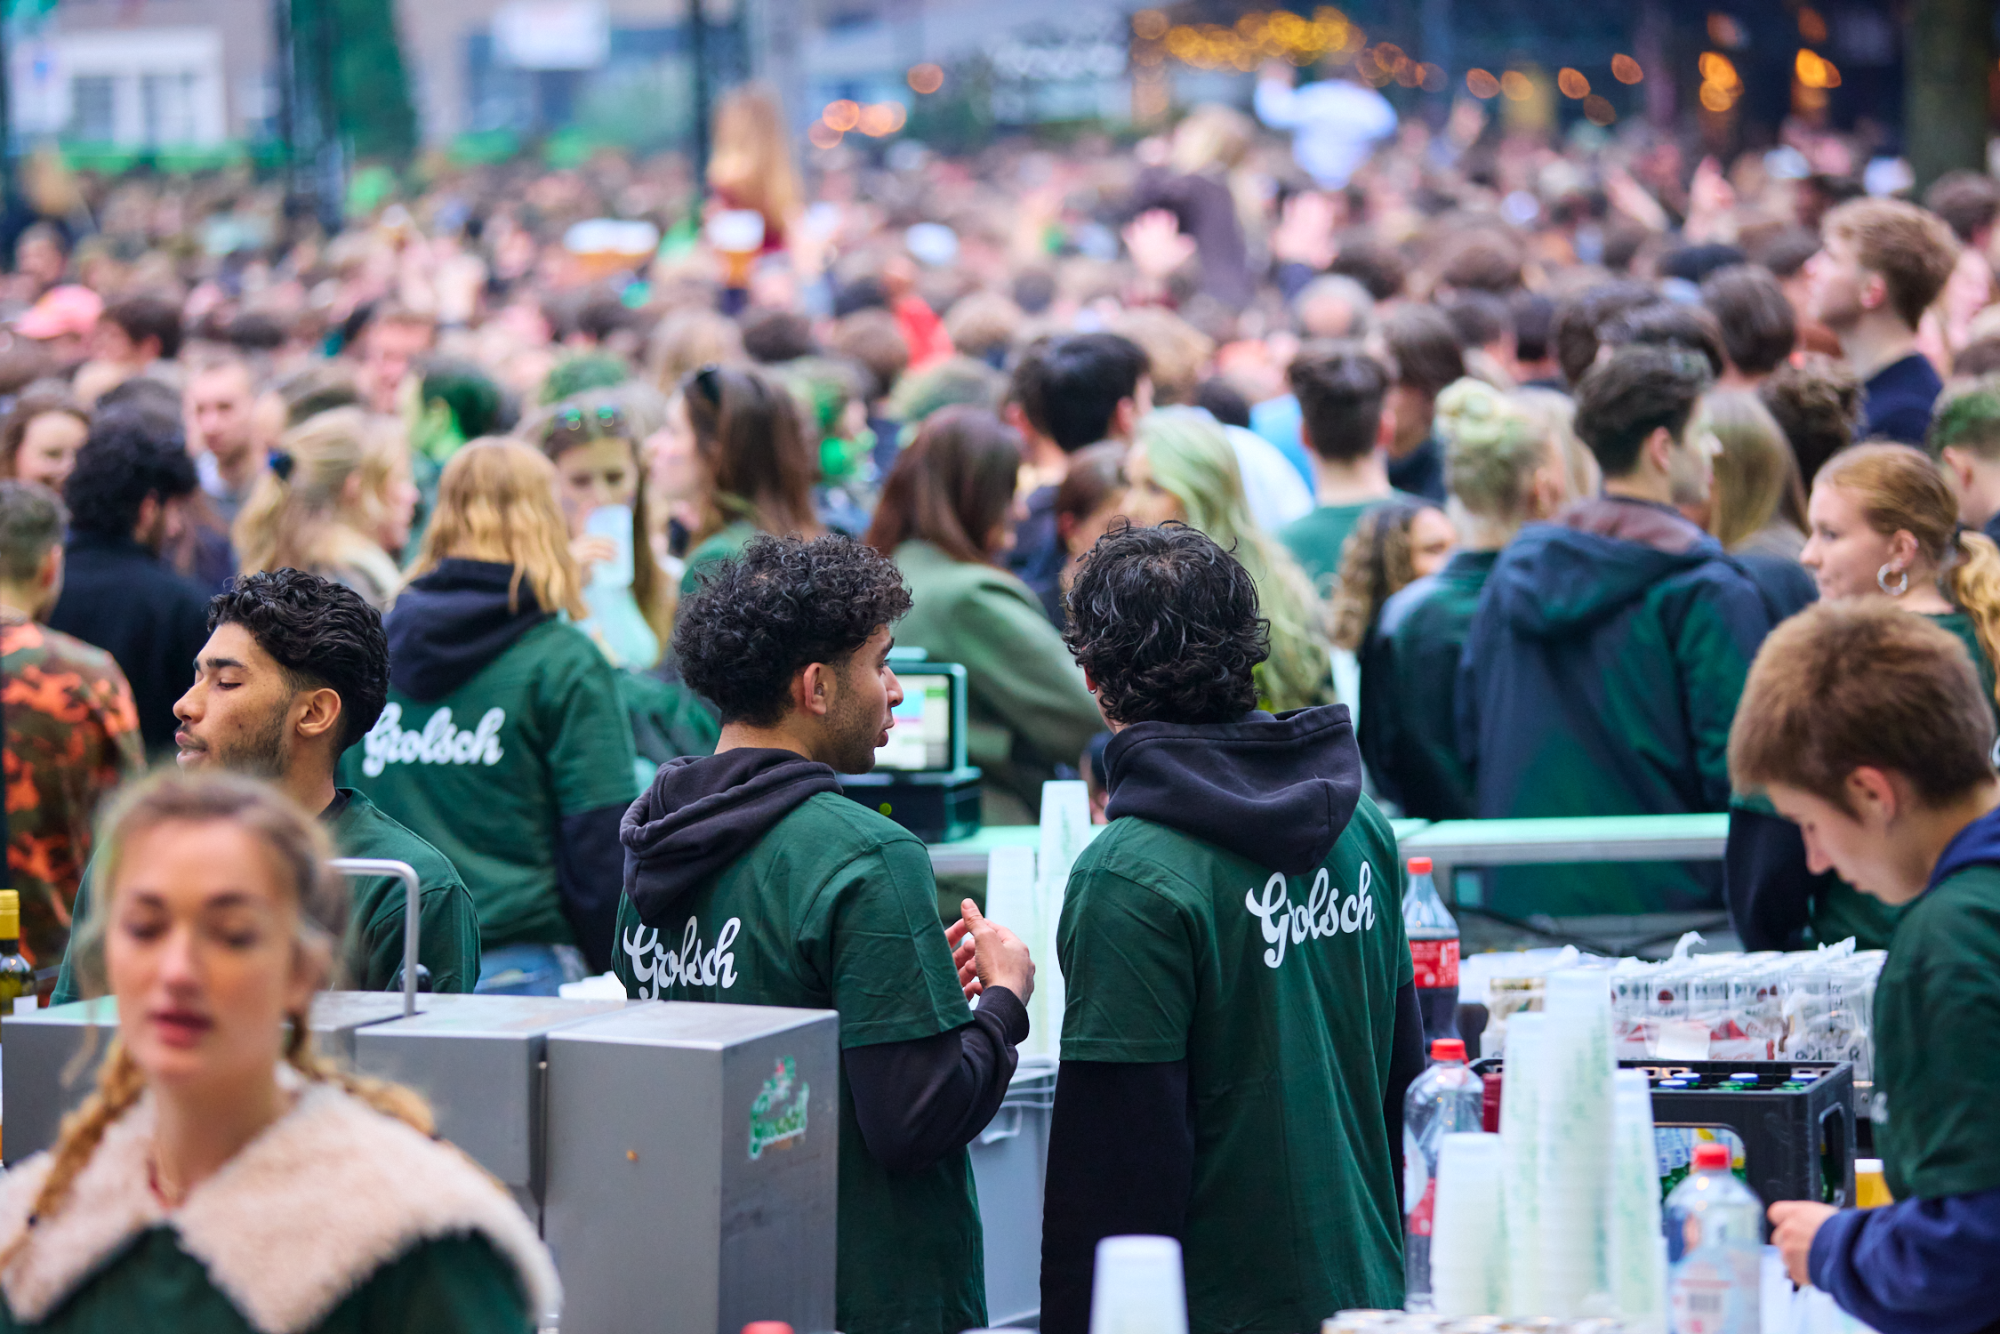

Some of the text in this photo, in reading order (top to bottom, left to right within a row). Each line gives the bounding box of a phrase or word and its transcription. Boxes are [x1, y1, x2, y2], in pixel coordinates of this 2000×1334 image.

[362, 702, 506, 778] Grolsch
[1245, 860, 1376, 969] Grolsch
[622, 915, 742, 1001] Grolsch
